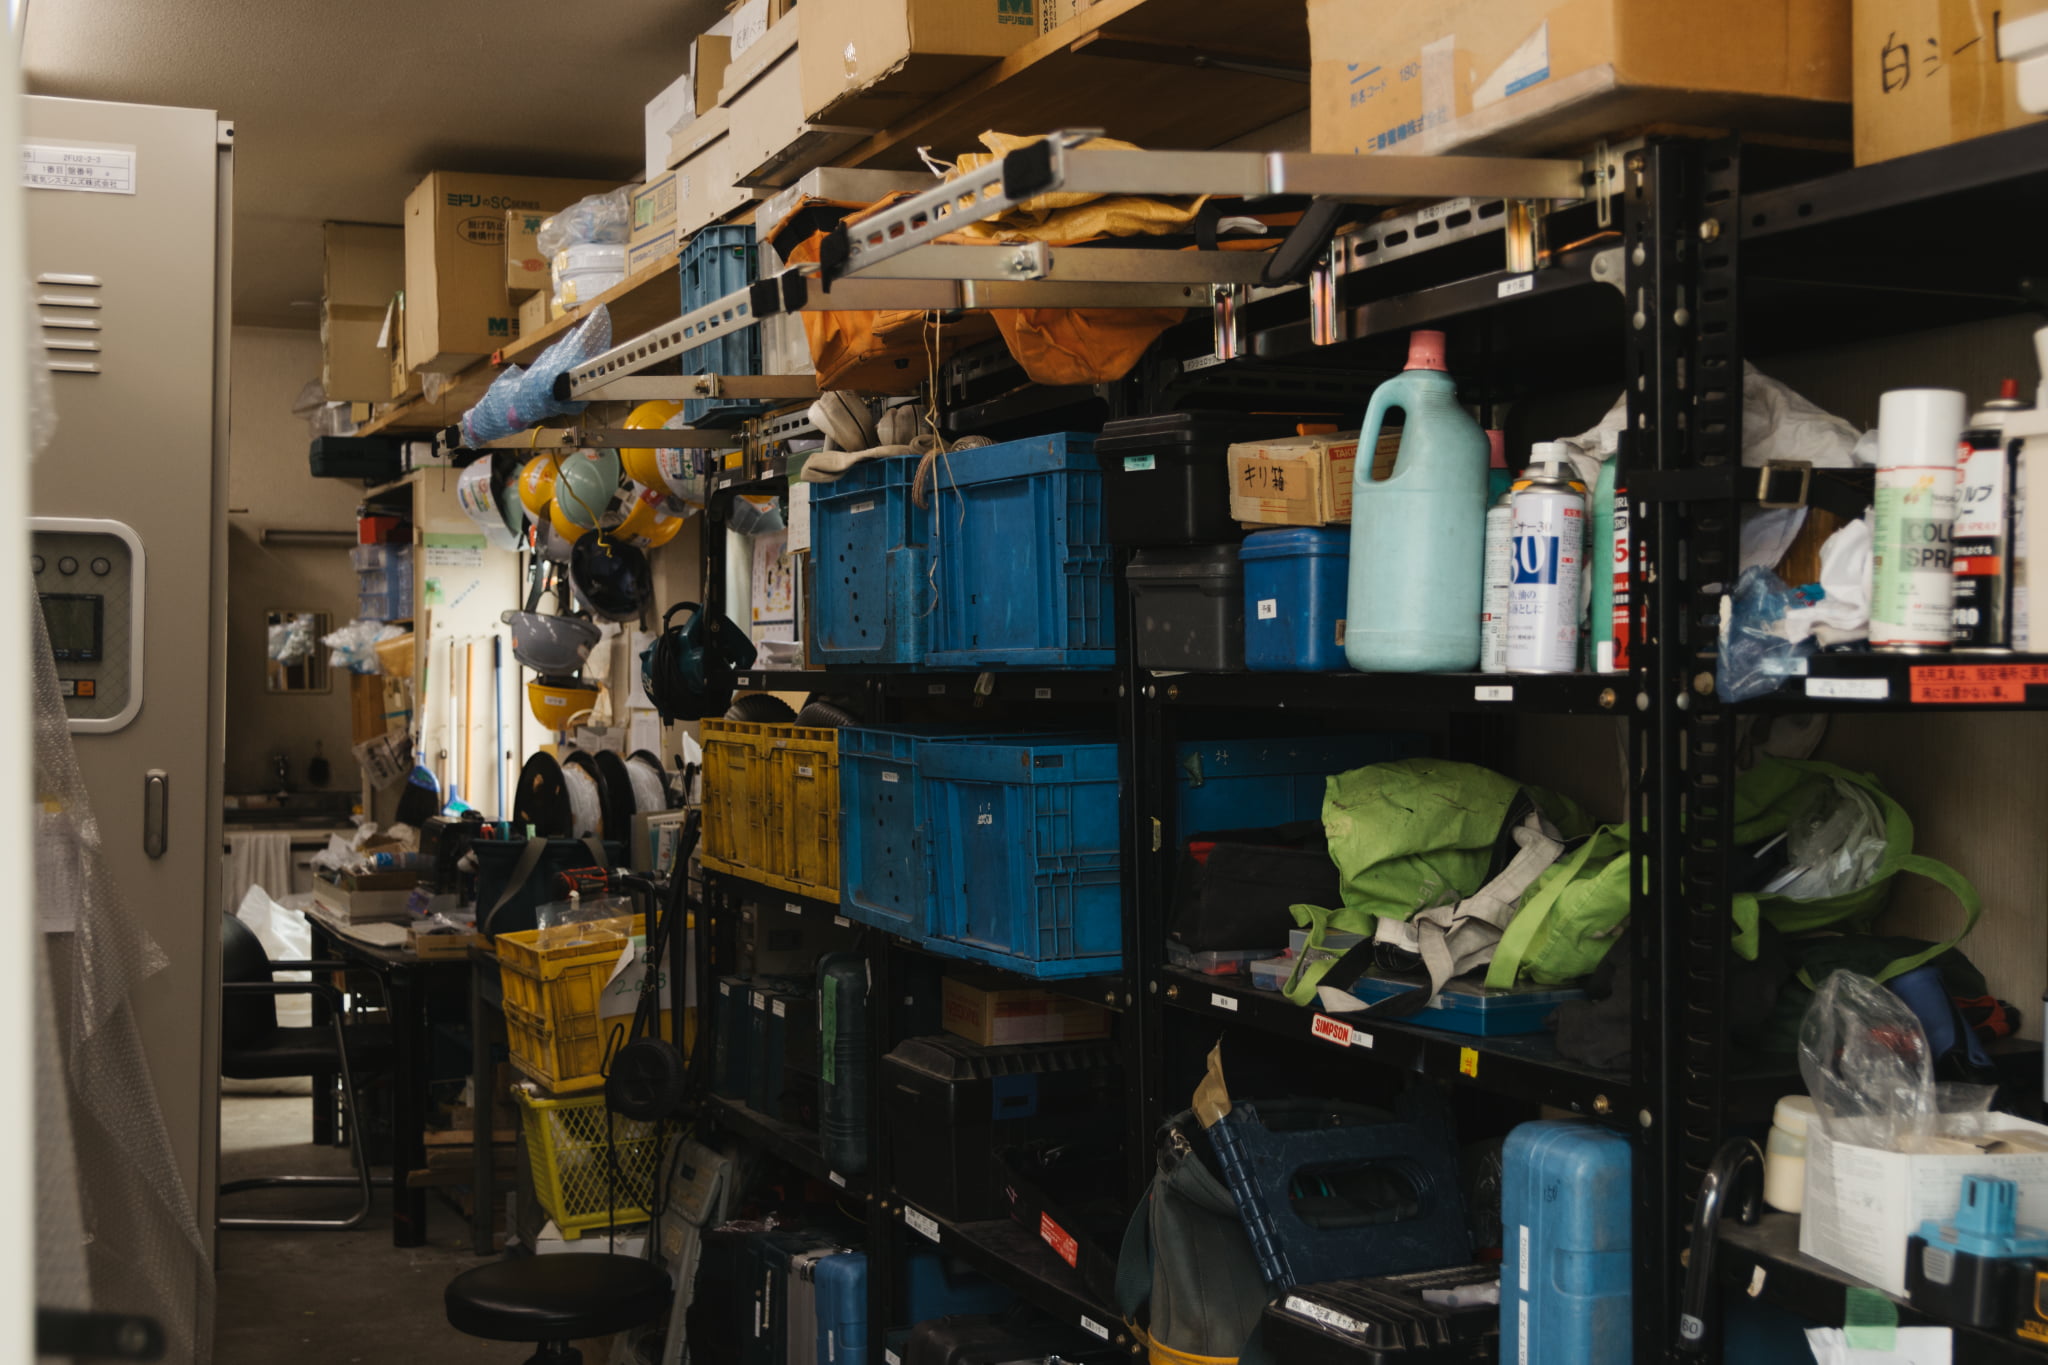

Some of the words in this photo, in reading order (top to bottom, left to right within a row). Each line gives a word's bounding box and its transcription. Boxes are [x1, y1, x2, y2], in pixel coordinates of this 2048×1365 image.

[1334, 447, 1358, 457] TAKI
[1244, 464, 1285, 492] キリ箱
[1315, 1018, 1349, 1042] SIMPSON
[1682, 1319, 1698, 1334] 60
